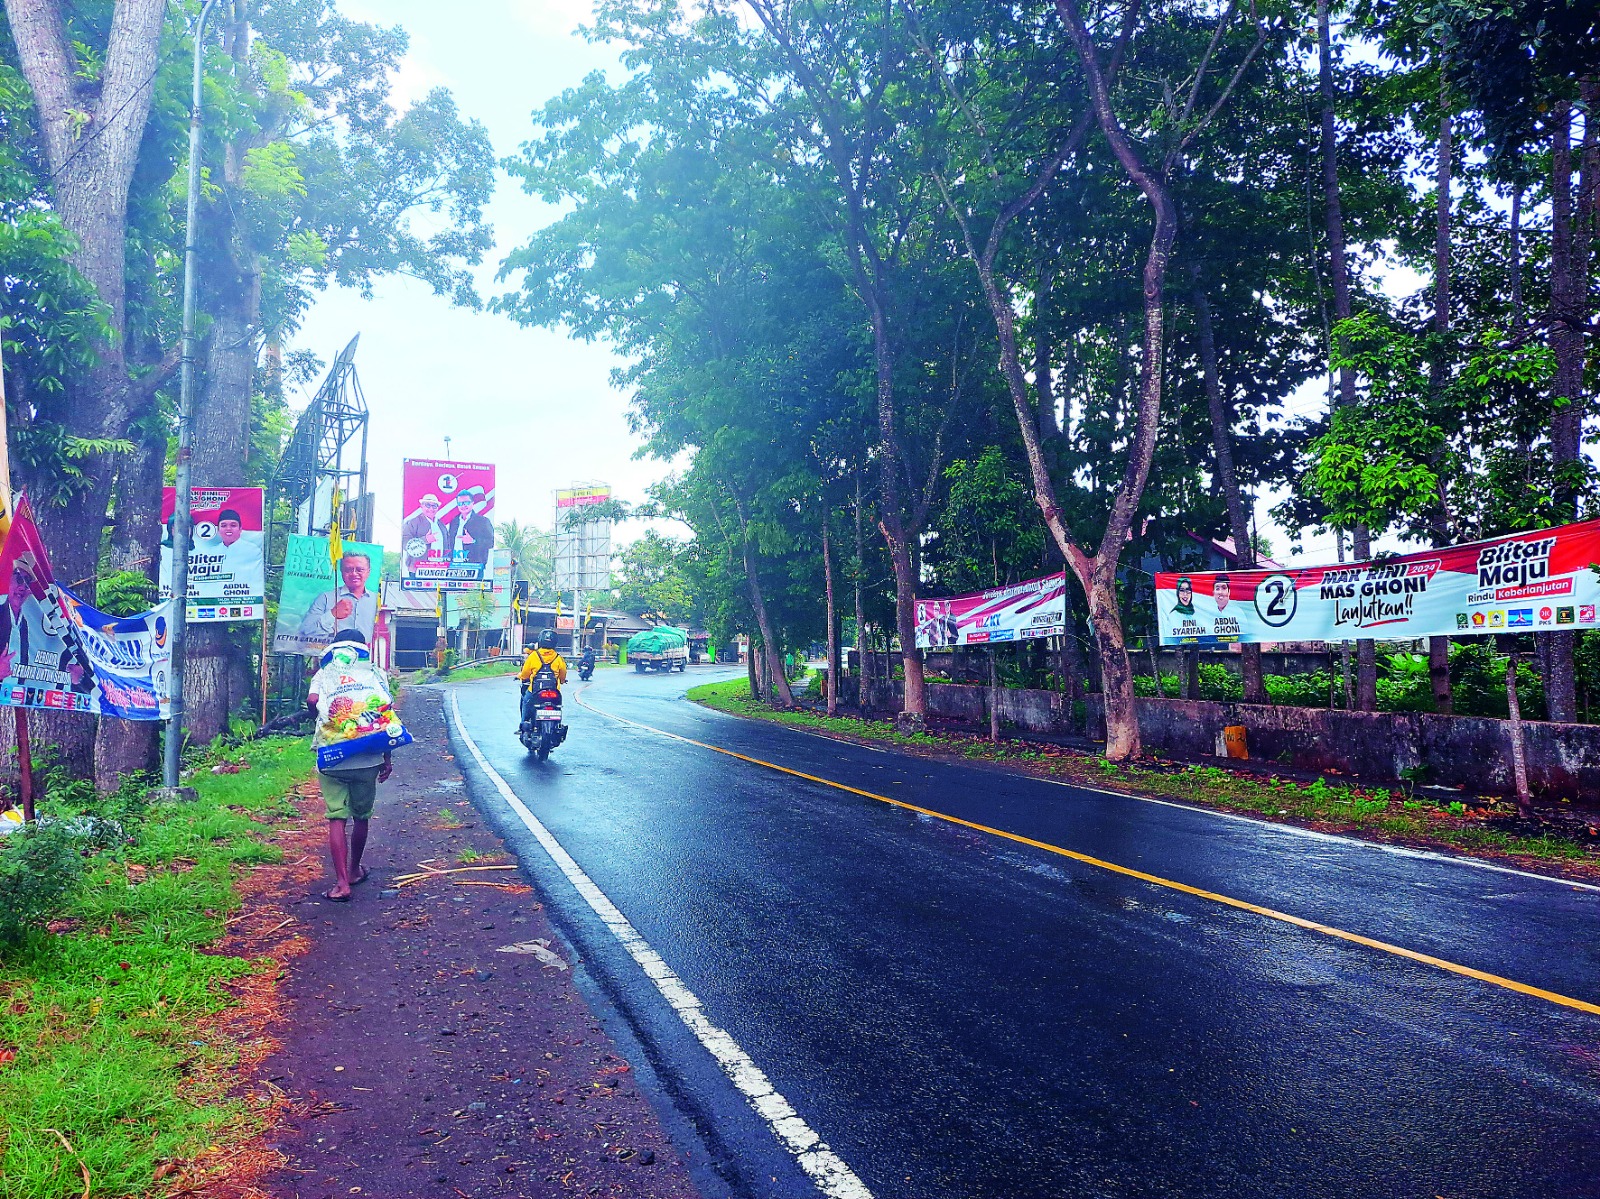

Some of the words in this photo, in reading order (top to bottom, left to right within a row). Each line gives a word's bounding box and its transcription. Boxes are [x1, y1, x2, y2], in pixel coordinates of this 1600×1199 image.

[443, 476, 452, 489] 1
[201, 524, 211, 538] 2
[1479, 539, 1553, 567] Blitar
[188, 563, 220, 576] Maju
[418, 569, 445, 577] WONGE
[1322, 569, 1361, 584] MAK
[1412, 564, 1436, 573] 2024
[1479, 558, 1546, 588] Maju
[1320, 584, 1355, 600] MAS
[1361, 576, 1426, 597] GHONI
[1468, 592, 1495, 603] Rindu
[1498, 581, 1569, 599] Keberlanjutan
[1265, 580, 1287, 617] 2
[1182, 619, 1197, 627] RINI
[1214, 617, 1239, 625] ABDUL
[1172, 627, 1206, 636] SYARIFAH
[1213, 625, 1241, 634] GHONI
